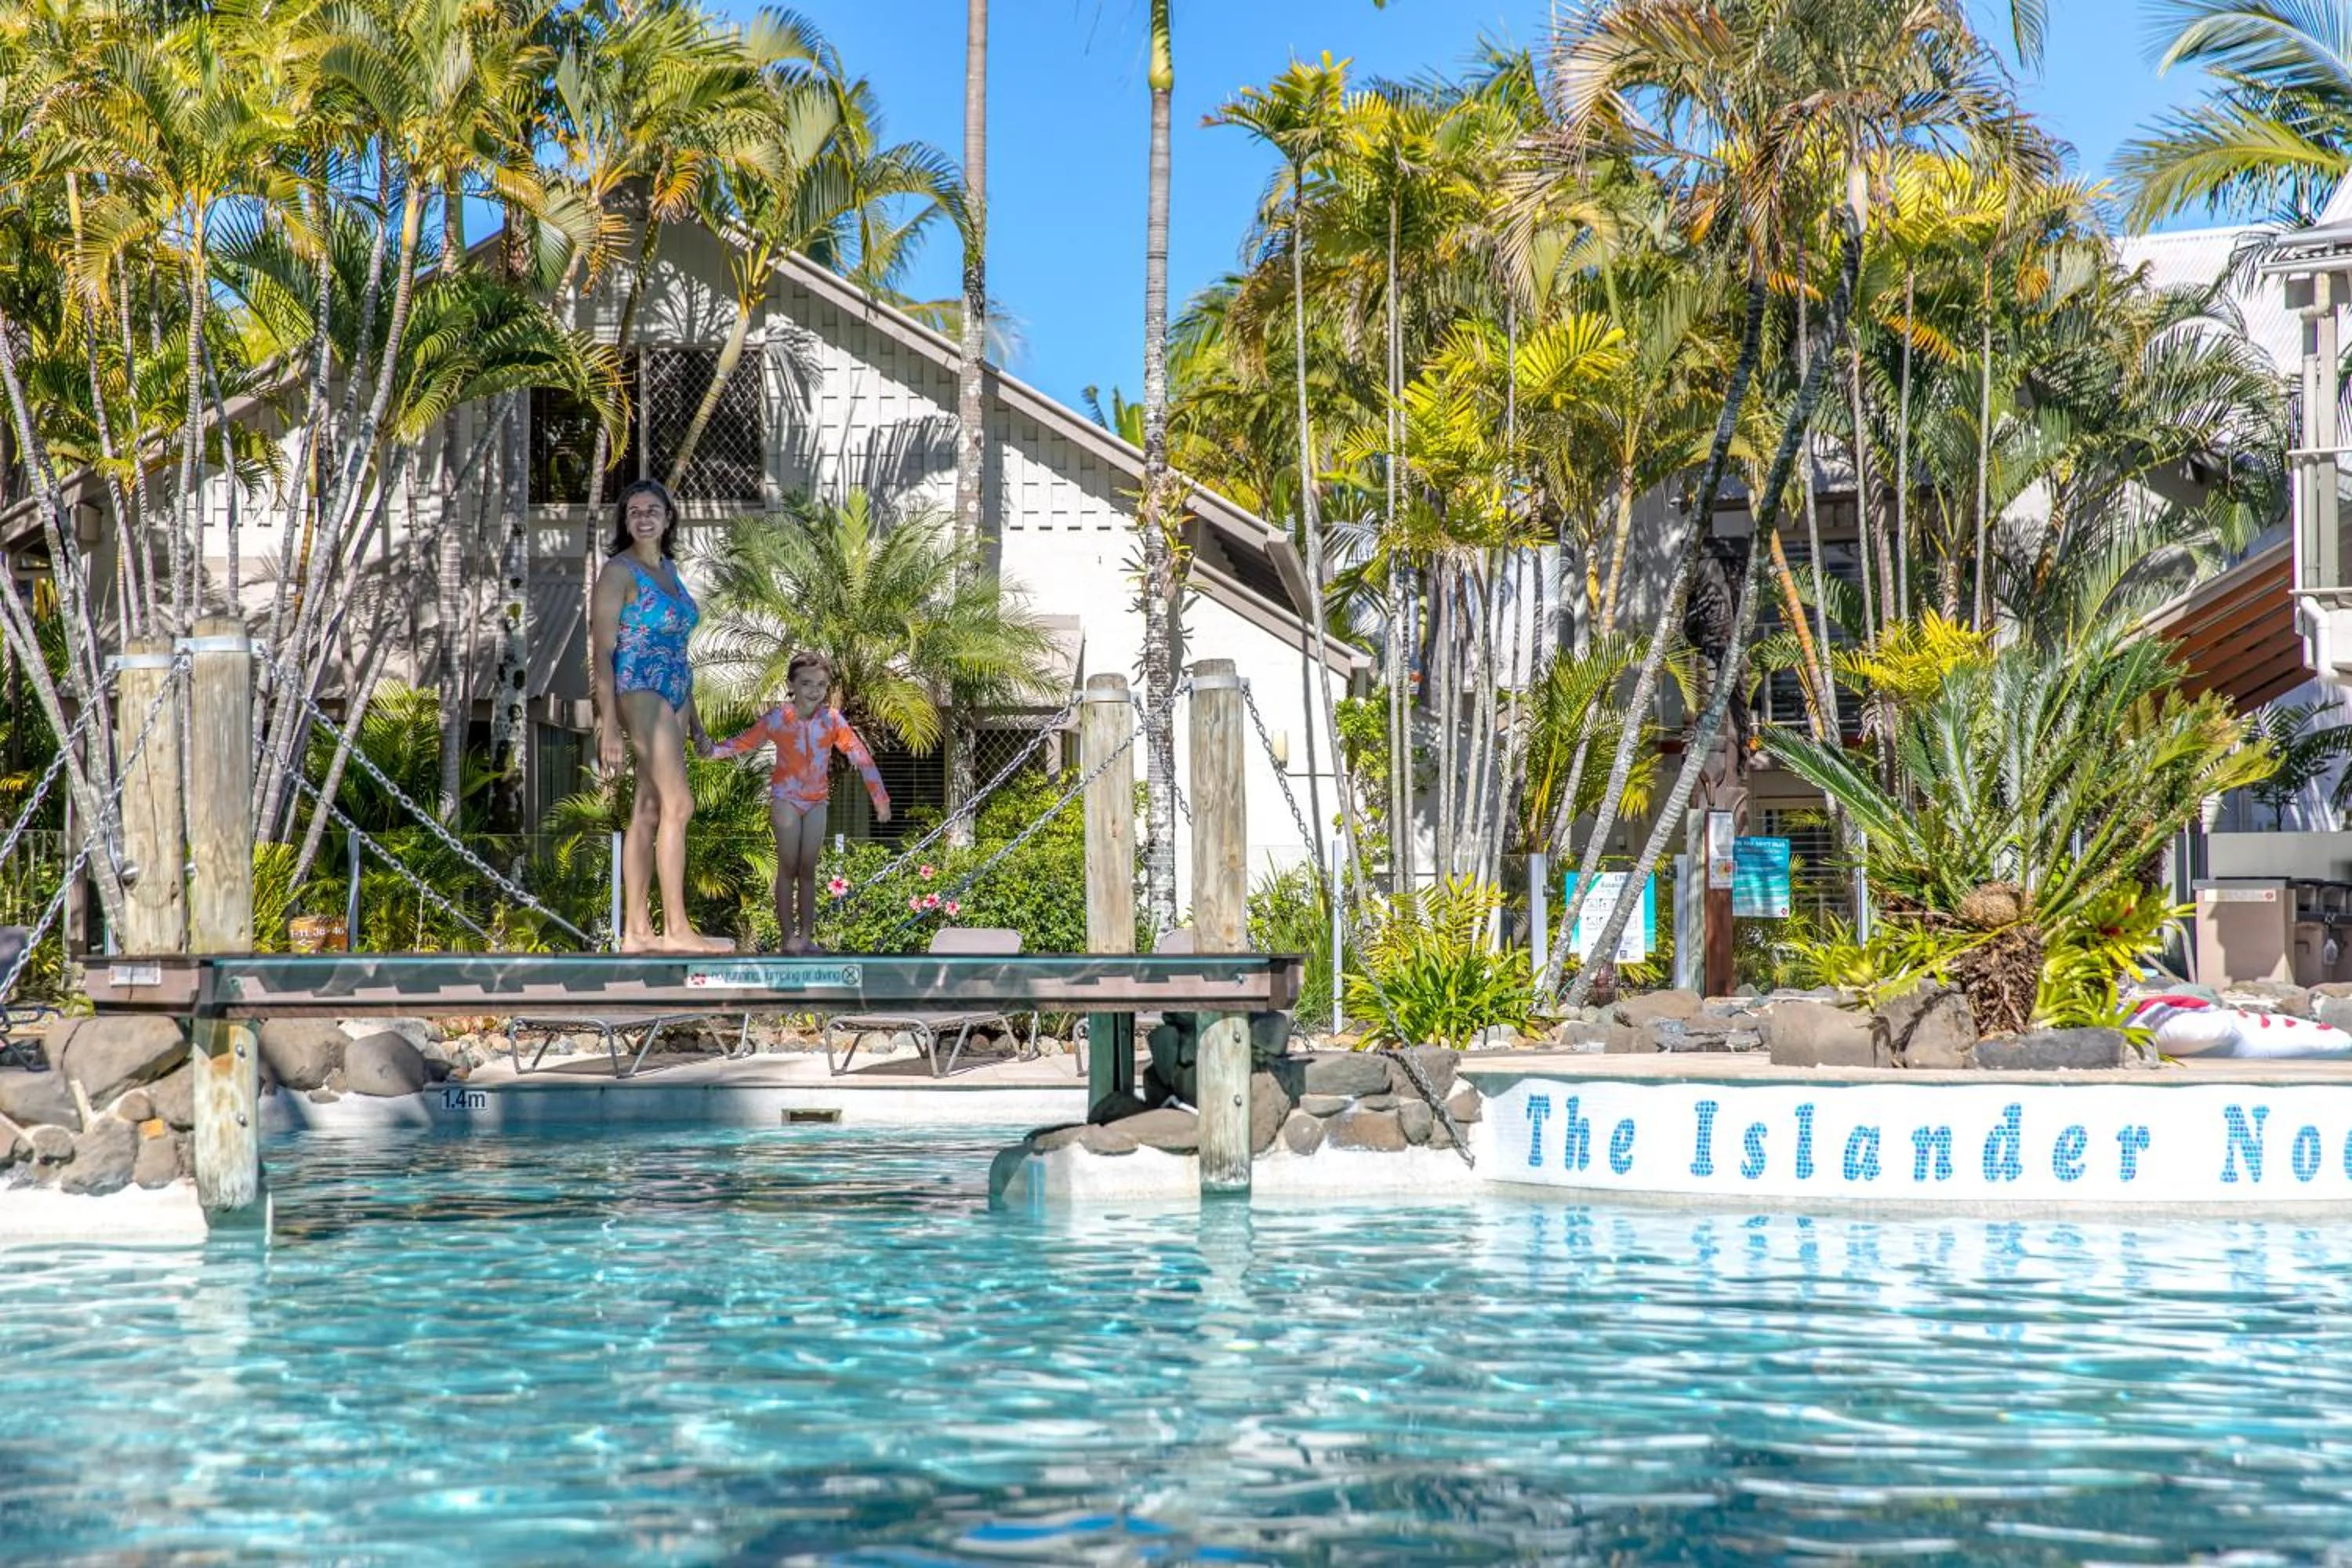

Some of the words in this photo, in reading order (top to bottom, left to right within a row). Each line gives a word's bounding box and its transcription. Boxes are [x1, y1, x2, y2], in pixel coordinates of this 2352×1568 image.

[442, 1089, 485, 1107] 1.4m
[1526, 1093, 1635, 1176] The
[1690, 1100, 2151, 1181] Islander
[2220, 1103, 2352, 1182] No
